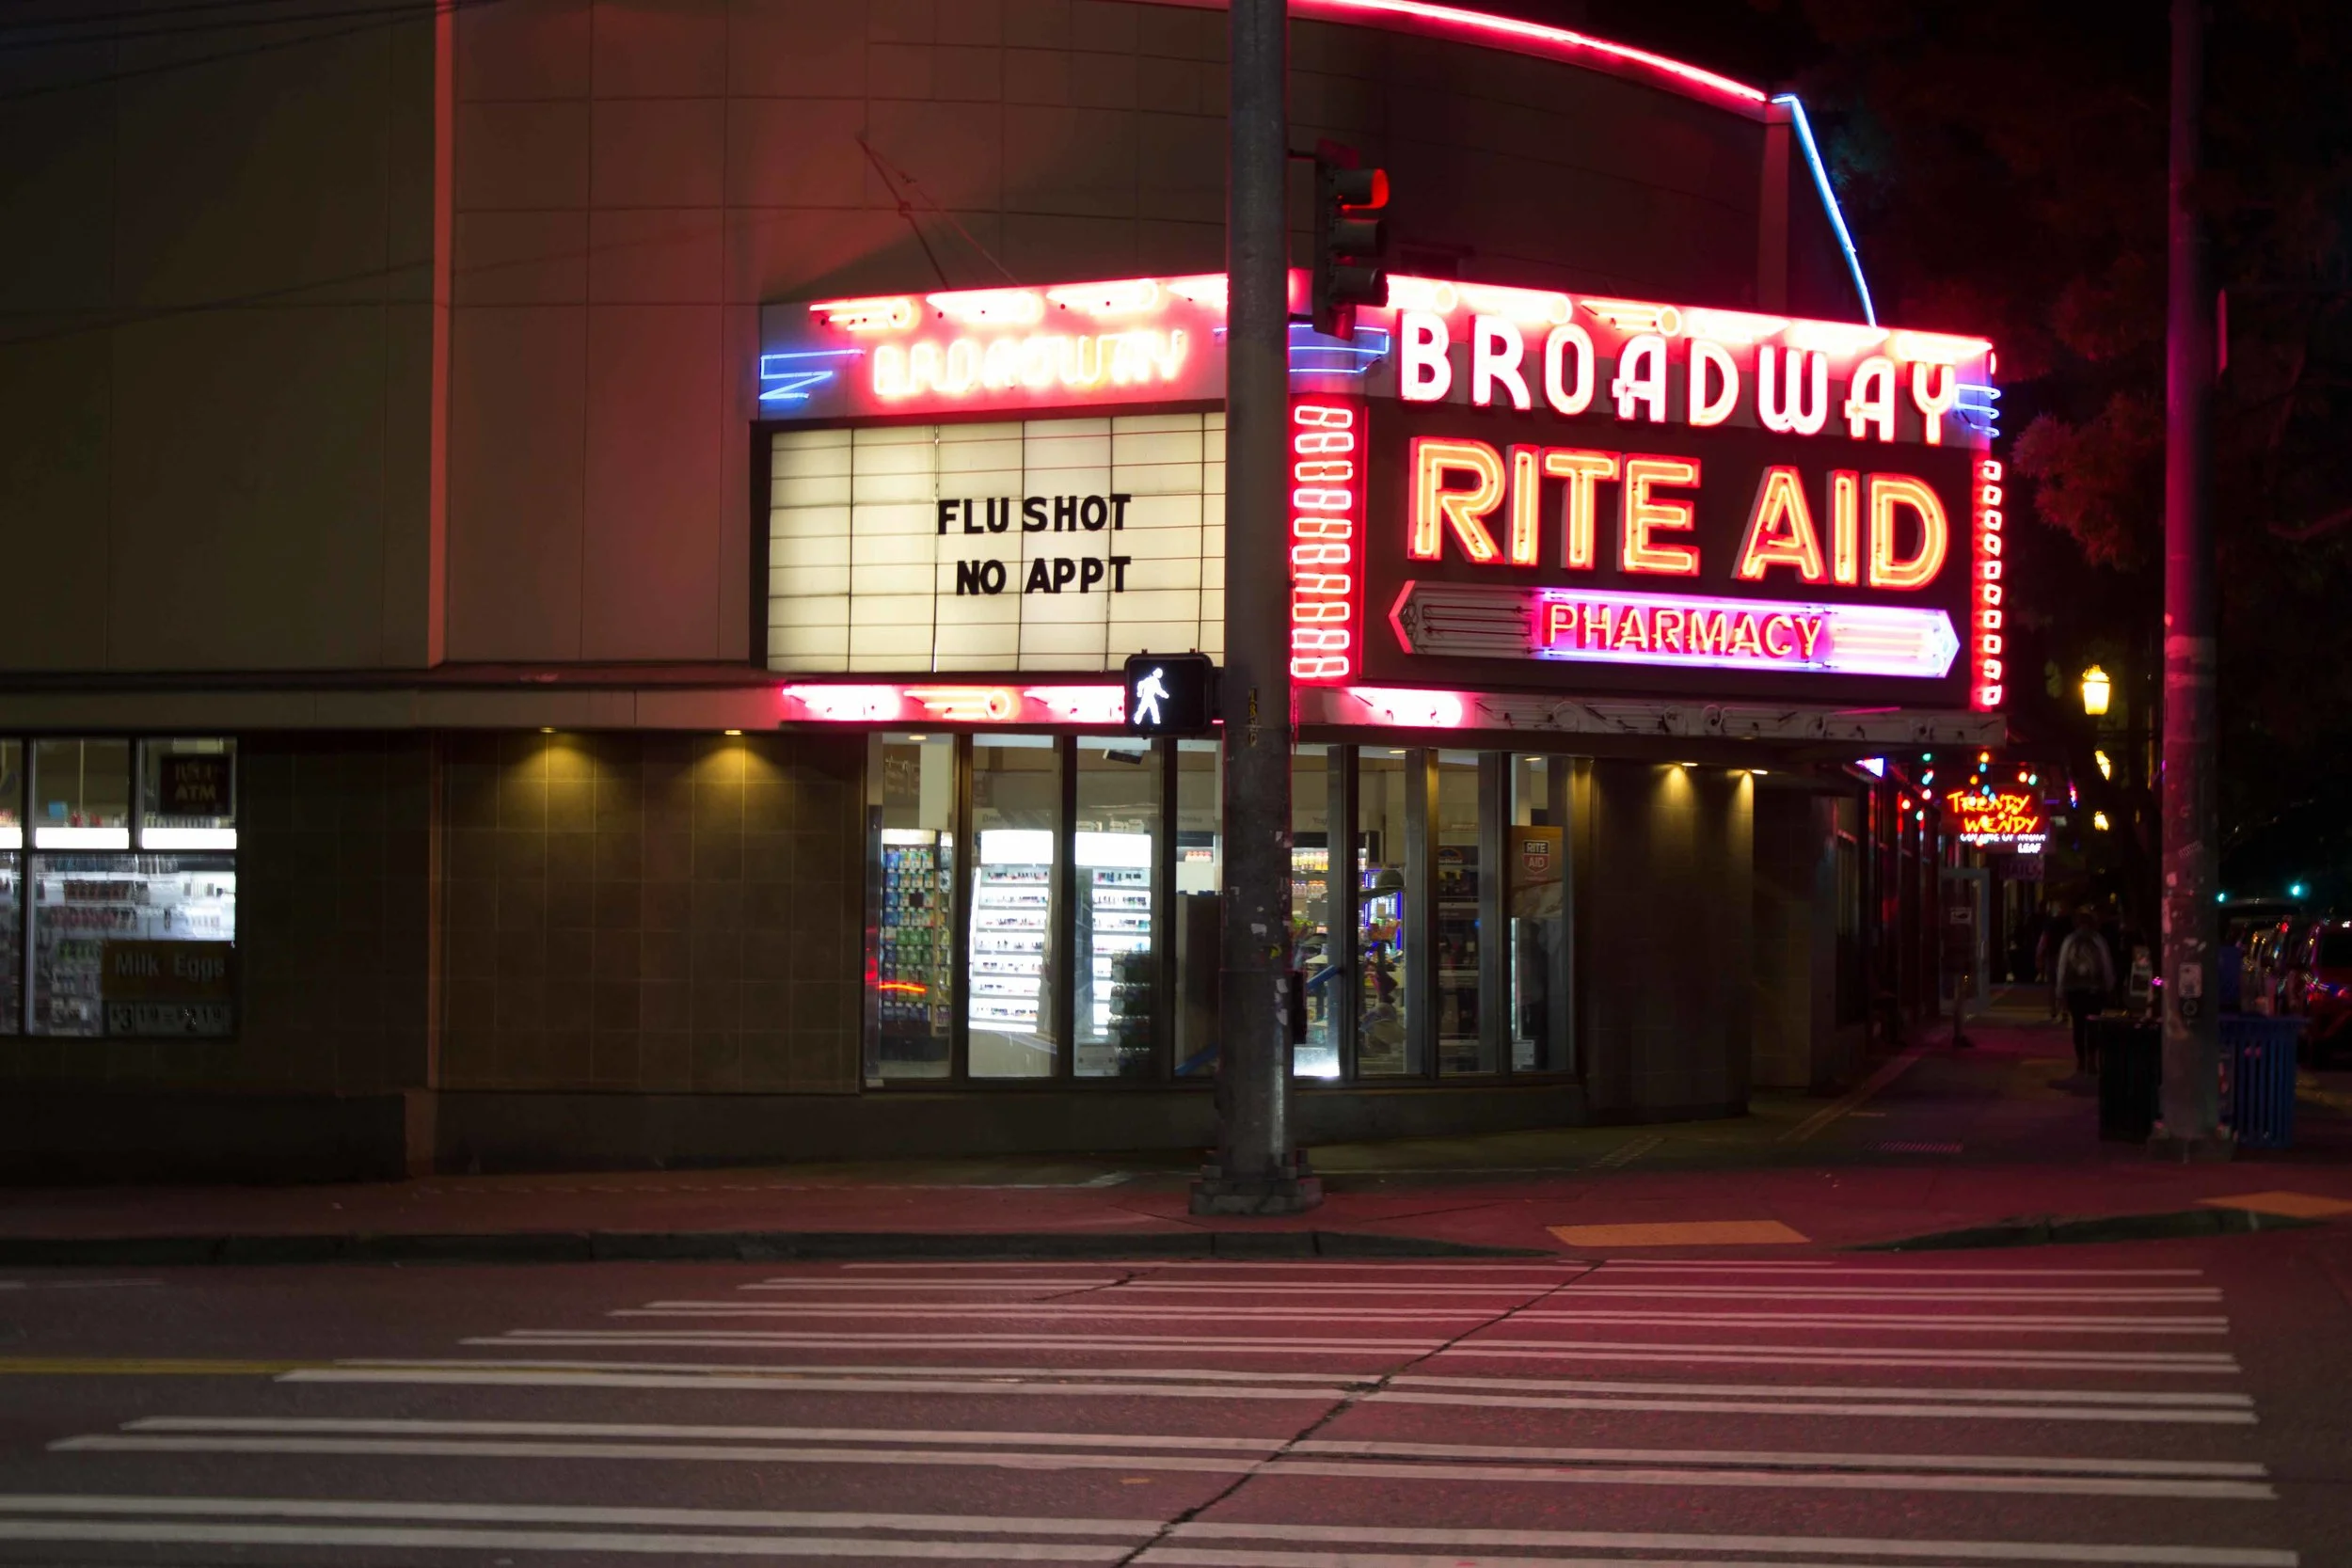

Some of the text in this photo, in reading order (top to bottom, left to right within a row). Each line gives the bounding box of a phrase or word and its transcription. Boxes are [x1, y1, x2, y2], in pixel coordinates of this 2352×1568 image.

[1397, 309, 1956, 445] BROADWAY
[938, 493, 1132, 534] FLU SHOT
[1406, 436, 1948, 590] RITE AID
[956, 557, 1132, 595] NO APPT
[1543, 601, 1822, 658] PHARMACY
[175, 784, 216, 801] ATM
[1947, 791, 2030, 815] TRENDY
[1963, 816, 2039, 833] WENDY
[1526, 843, 1548, 853] RITE
[2017, 843, 2042, 853] LEAF
[1528, 857, 1545, 867] AID
[115, 952, 225, 983] Milk Eggs
